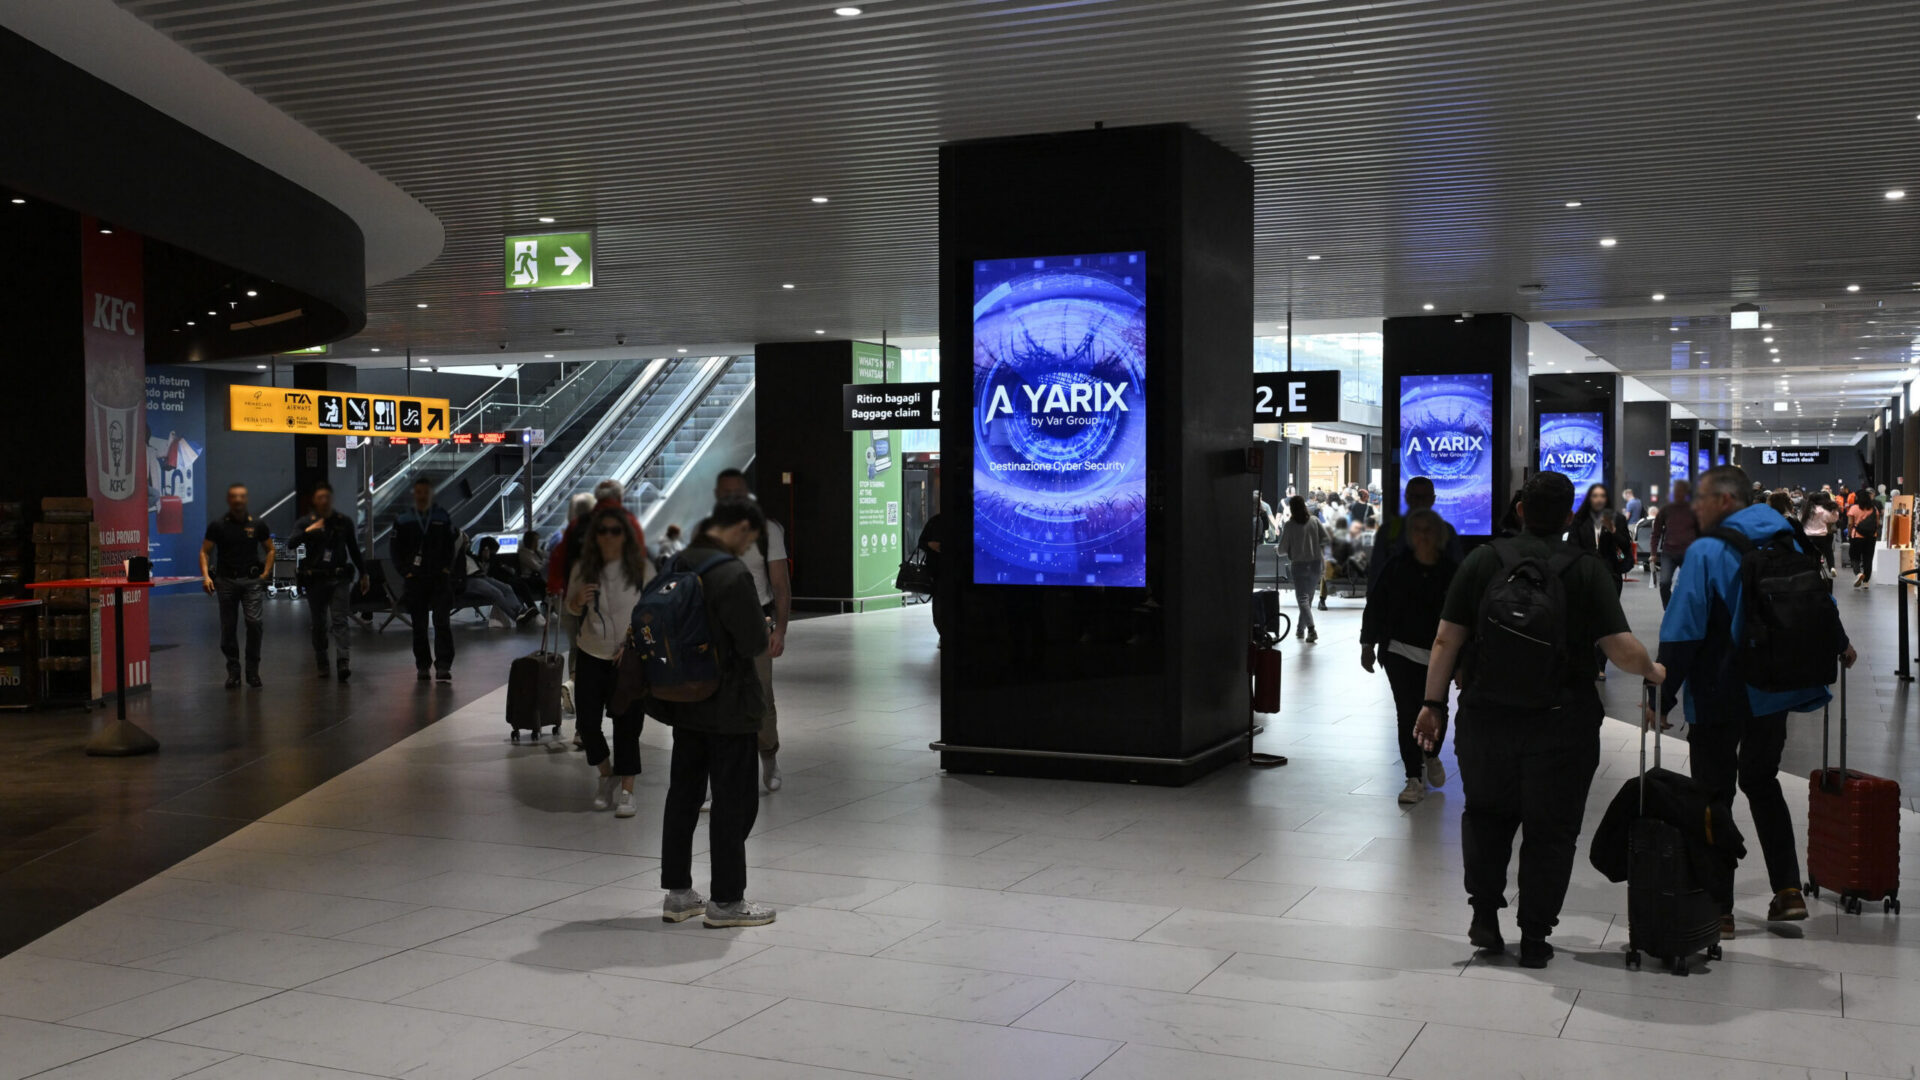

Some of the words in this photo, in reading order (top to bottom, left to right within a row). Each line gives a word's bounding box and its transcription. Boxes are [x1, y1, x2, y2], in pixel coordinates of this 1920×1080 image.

[93, 292, 136, 336] KFC
[881, 359, 895, 369] NW?
[159, 375, 190, 388] Return
[163, 389, 185, 401] parti
[284, 393, 312, 405] ITA
[856, 394, 883, 404] Ritiro
[885, 393, 921, 405] bagagli
[1021, 382, 1130, 413] YARIX
[161, 402, 184, 412] torni
[851, 409, 892, 421] Baggage
[894, 408, 921, 418] claim
[1031, 416, 1043, 427] by
[1046, 416, 1063, 426] Var
[1066, 415, 1099, 427] Group
[1426, 435, 1484, 452] YARIX
[1558, 453, 1597, 464] YARIX
[989, 461, 1051, 472] Destinazione
[1053, 461, 1082, 473] Cyber
[1084, 460, 1126, 473] Security
[109, 479, 127, 493] KFC
[106, 528, 116, 545] GIÀ
[117, 530, 141, 544] PROVATO
